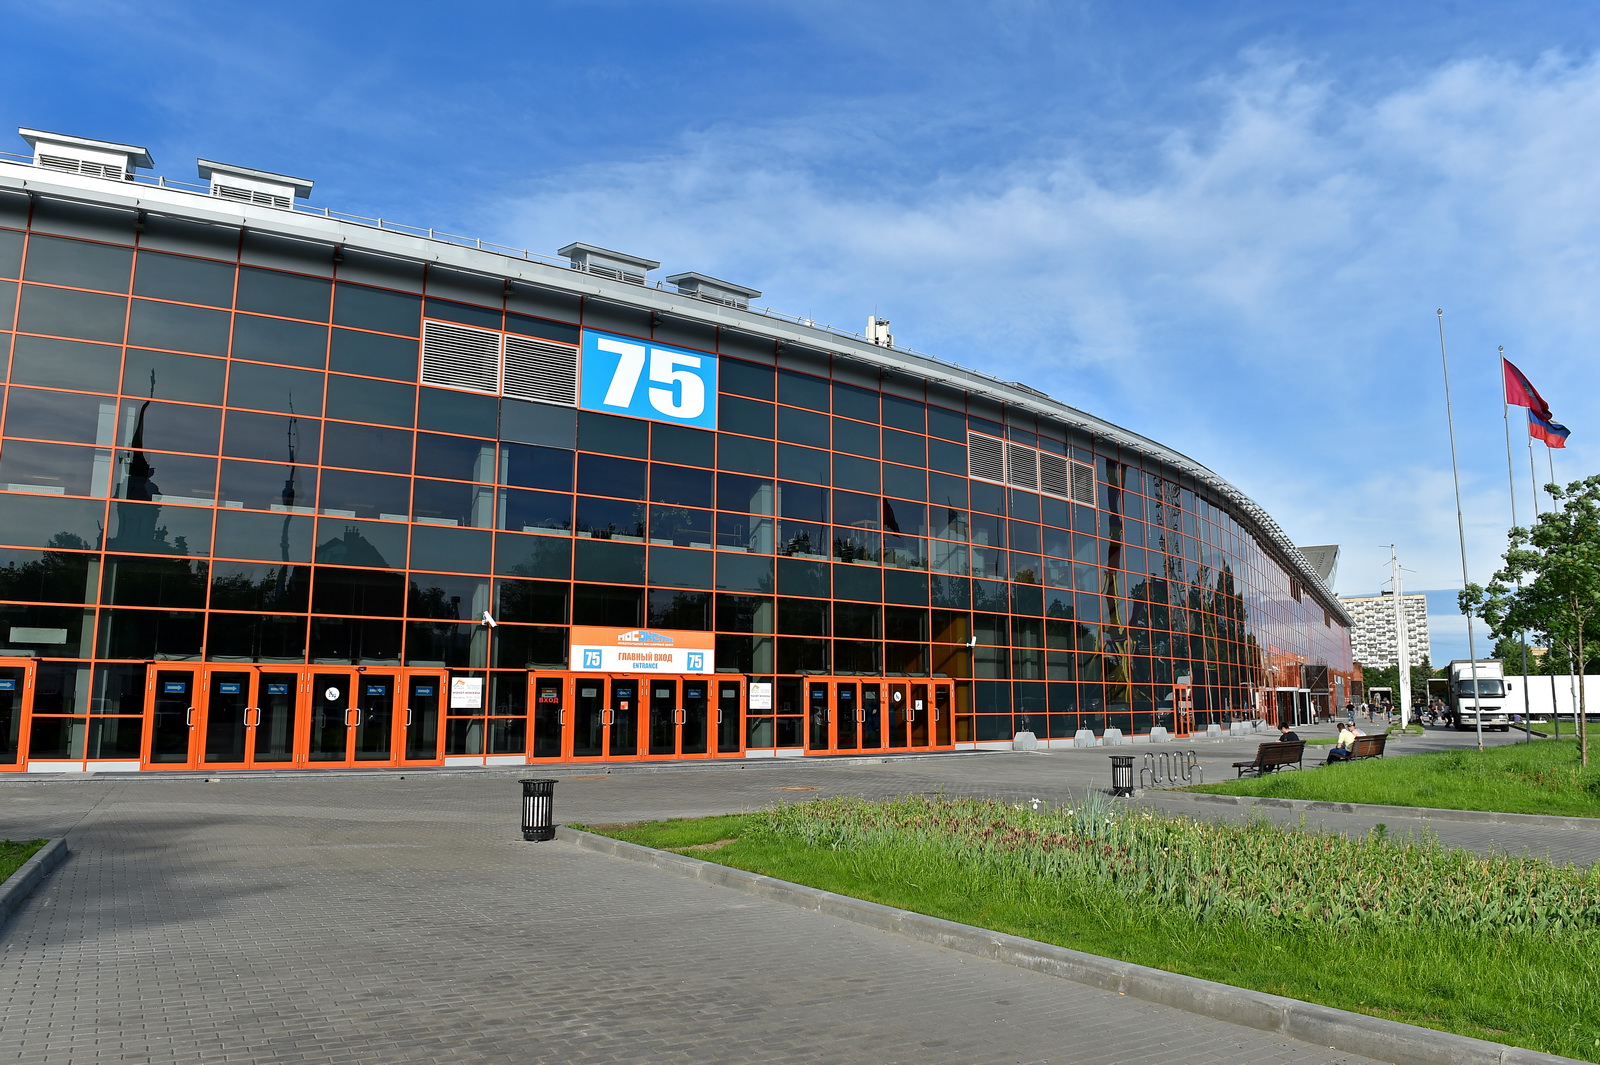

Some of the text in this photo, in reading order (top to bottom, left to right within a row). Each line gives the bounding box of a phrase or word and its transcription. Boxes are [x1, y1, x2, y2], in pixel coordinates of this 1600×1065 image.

[598, 338, 704, 418] 75
[586, 652, 600, 666] 75
[618, 652, 673, 663] ГЛАВНЫЙ ВХОД
[689, 653, 703, 668] 75
